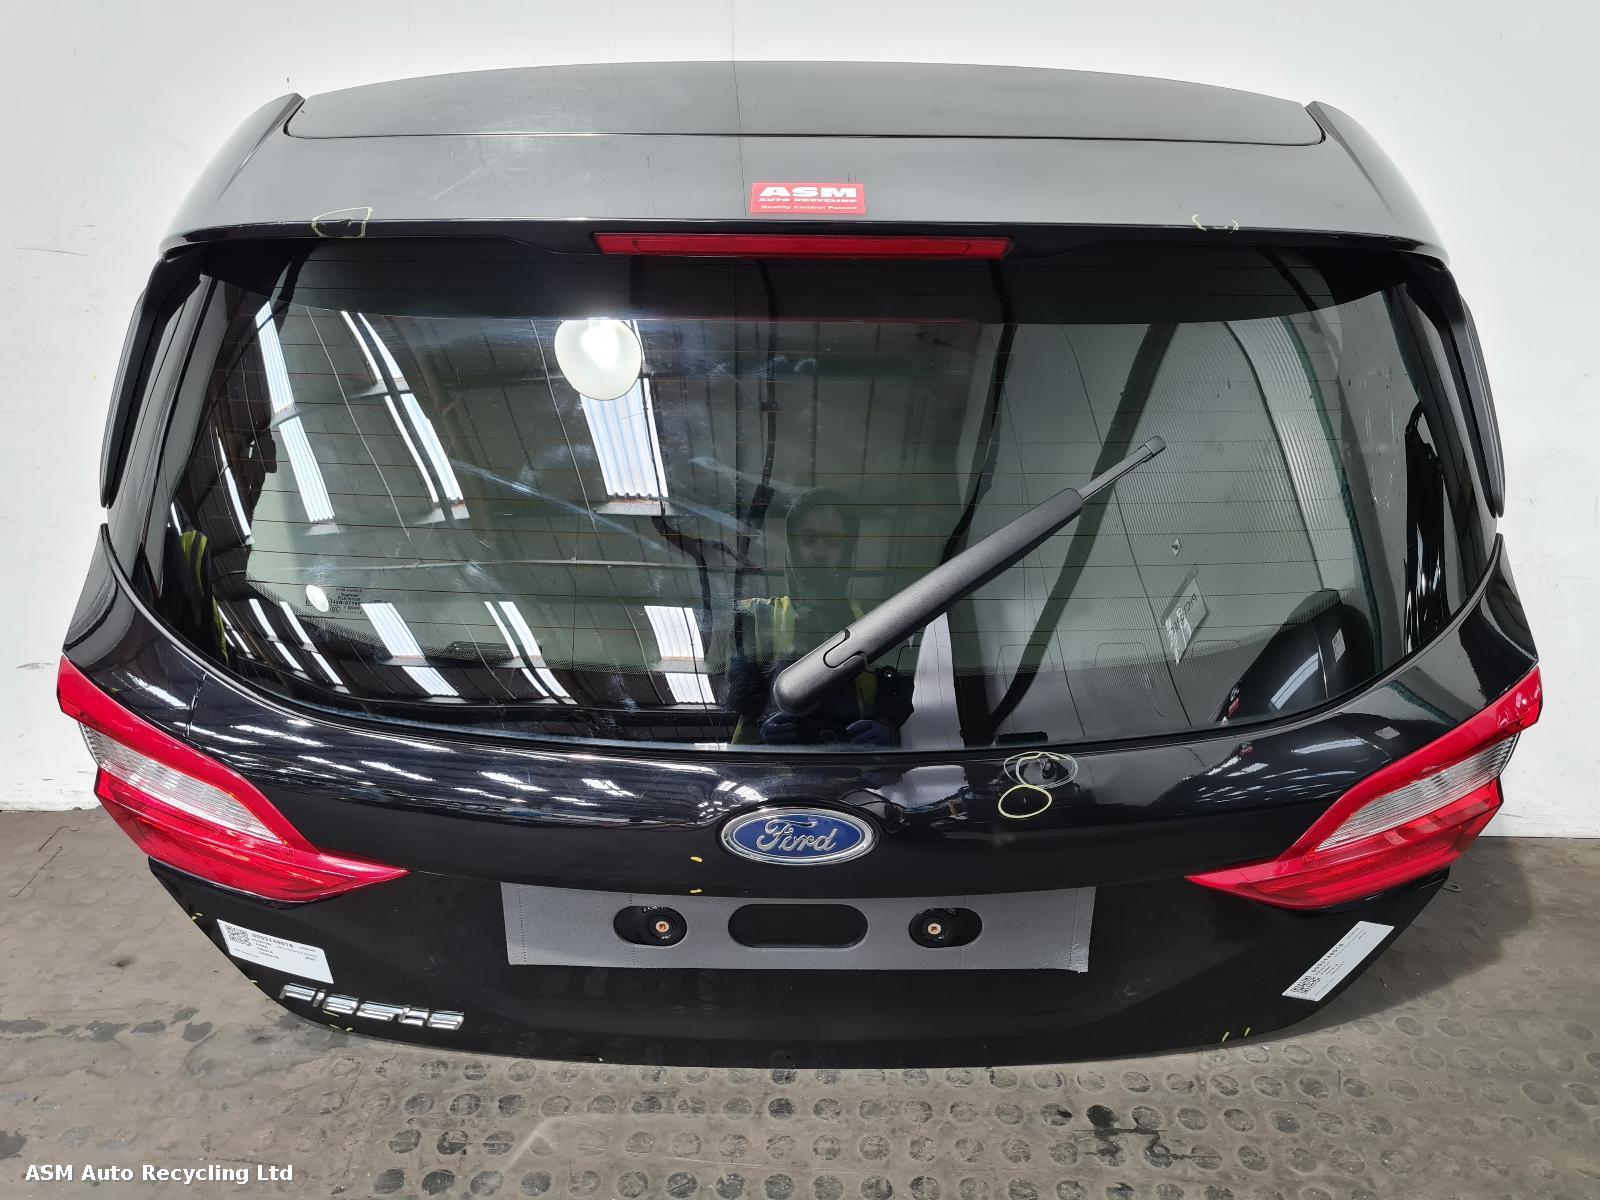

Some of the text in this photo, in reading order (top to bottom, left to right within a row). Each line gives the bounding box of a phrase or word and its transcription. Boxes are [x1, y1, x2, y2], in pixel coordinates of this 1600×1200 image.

[760, 186, 857, 198] ASM
[756, 819, 838, 851] Ford
[279, 983, 464, 1030] Fiesta
